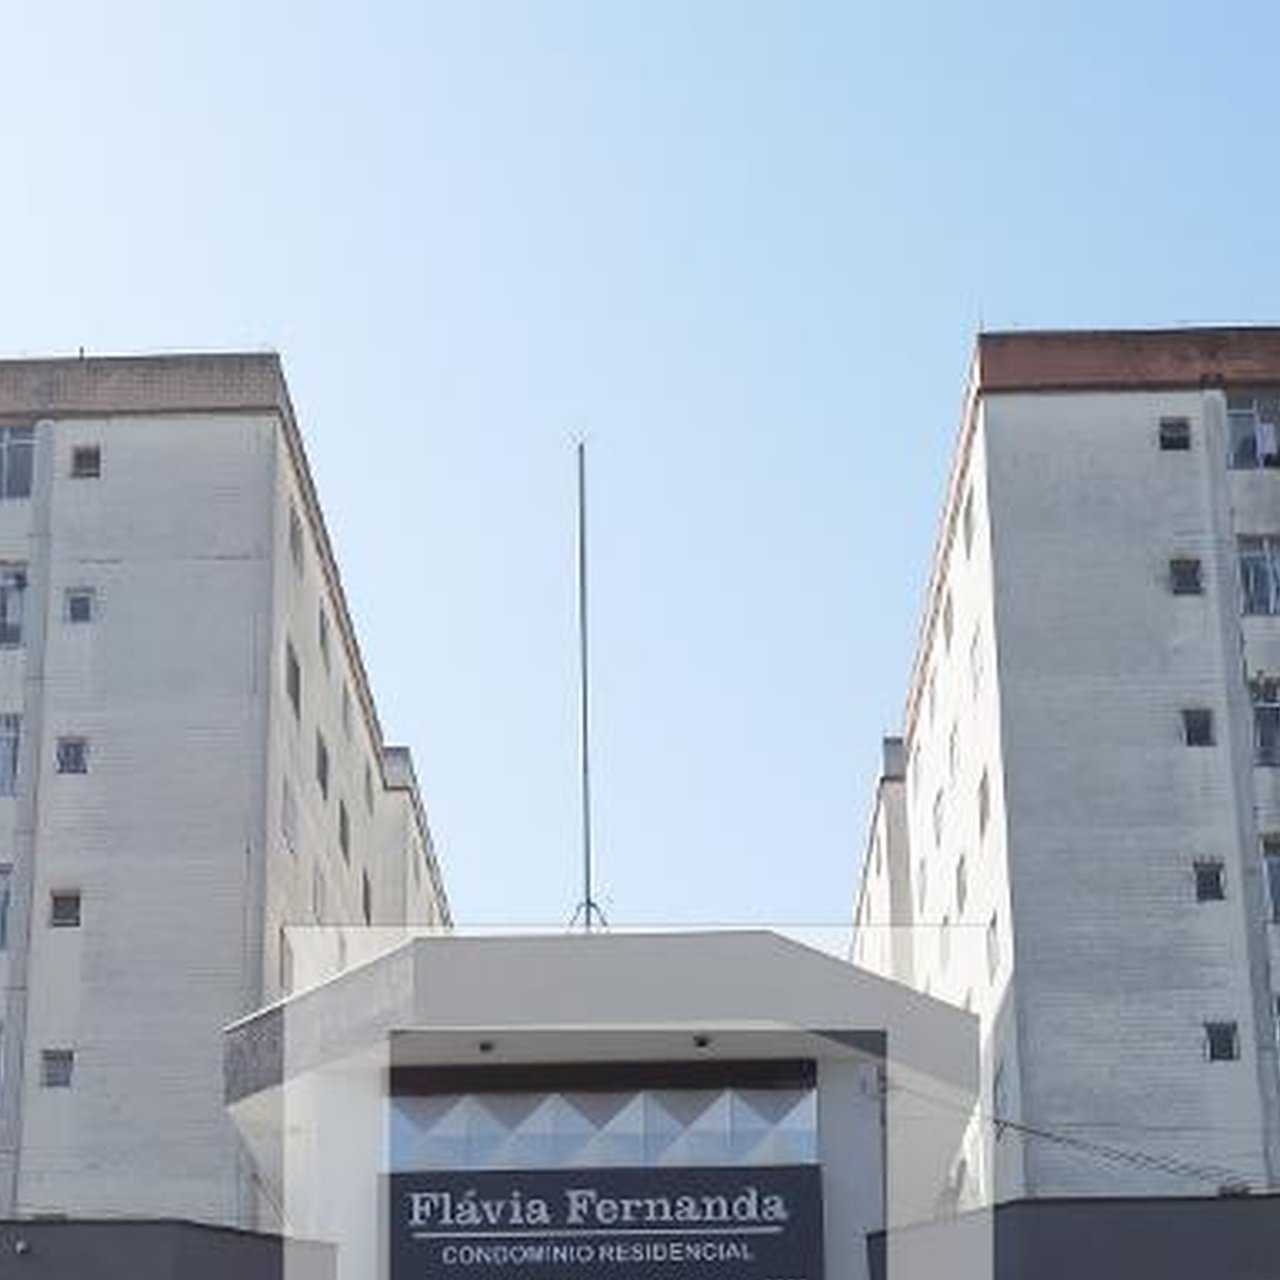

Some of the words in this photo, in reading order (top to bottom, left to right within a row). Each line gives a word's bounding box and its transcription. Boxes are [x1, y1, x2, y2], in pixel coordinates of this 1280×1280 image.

[408, 1188, 551, 1226] Flávia
[565, 1186, 789, 1226] Fernanda
[599, 1242, 755, 1263] RESIDENCIAL
